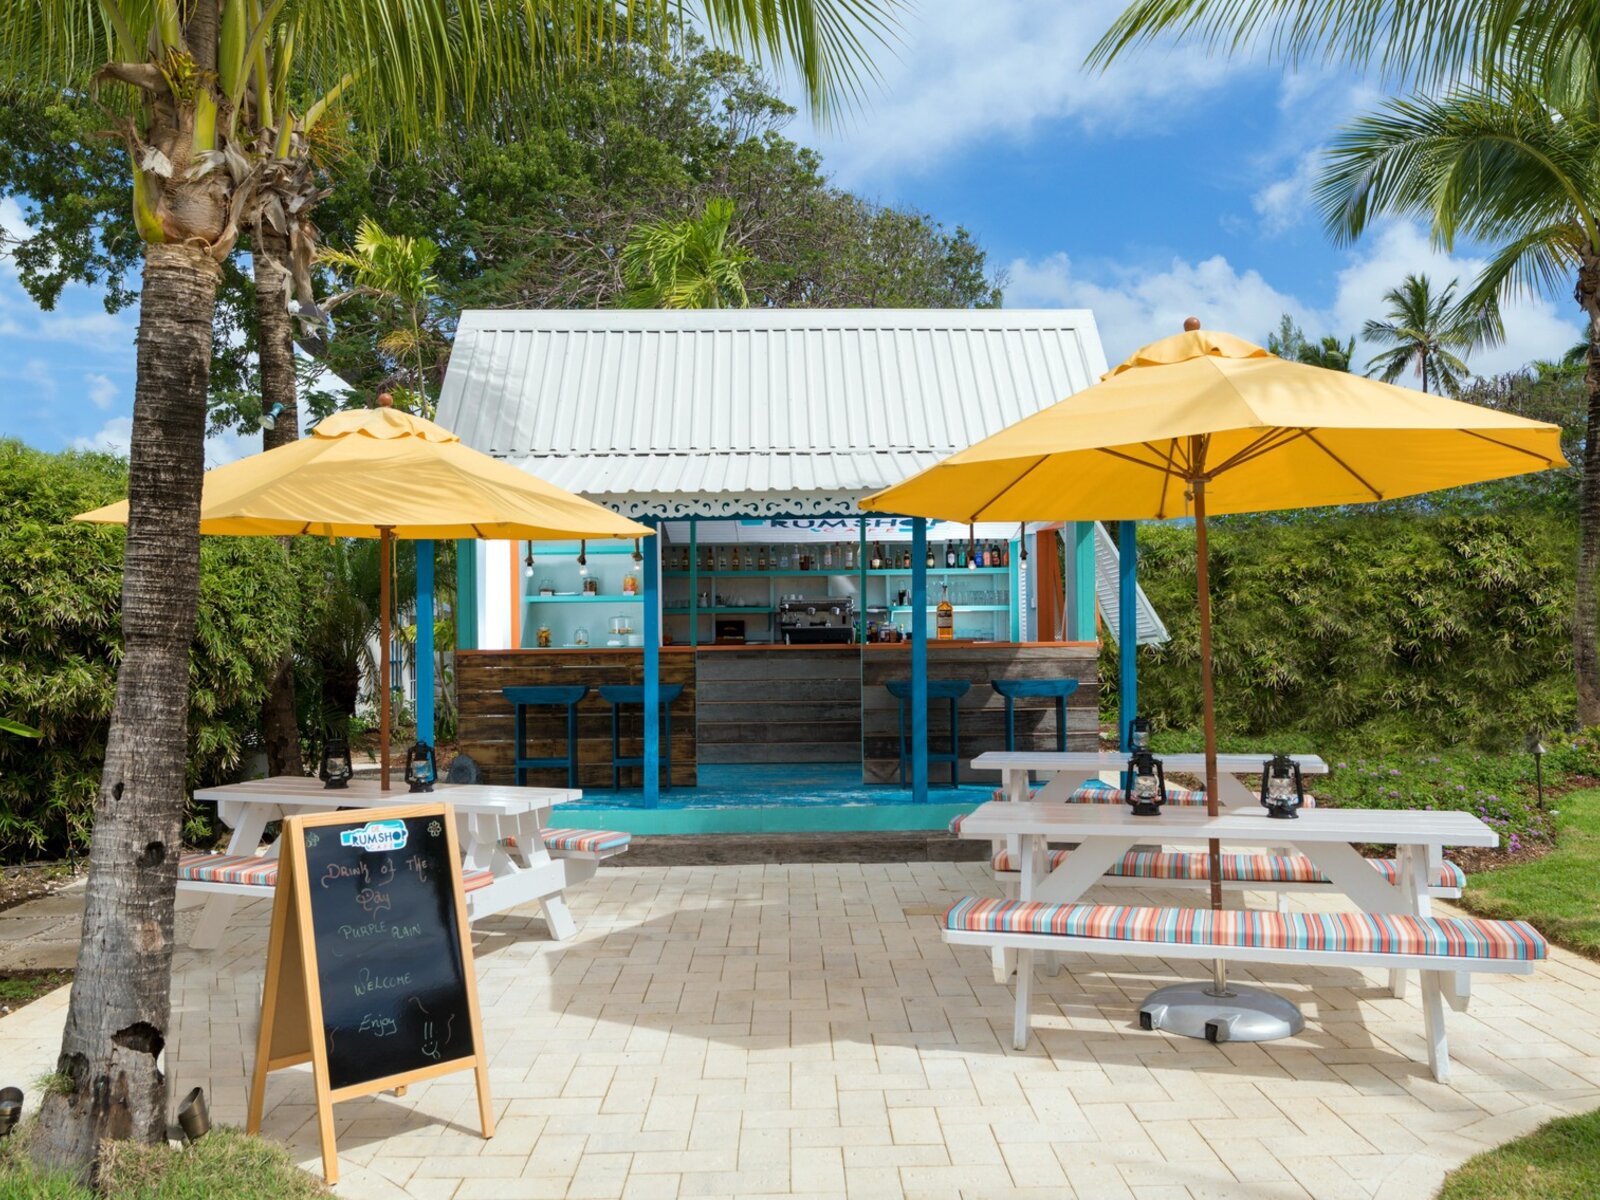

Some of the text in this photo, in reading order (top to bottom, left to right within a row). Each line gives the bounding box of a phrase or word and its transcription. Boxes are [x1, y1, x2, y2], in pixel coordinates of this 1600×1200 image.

[352, 830, 407, 846] RUMSHOP
[339, 922, 422, 939] PURPLE RAIN
[354, 968, 412, 996] WELCOME
[359, 1013, 397, 1036] Enjoy
